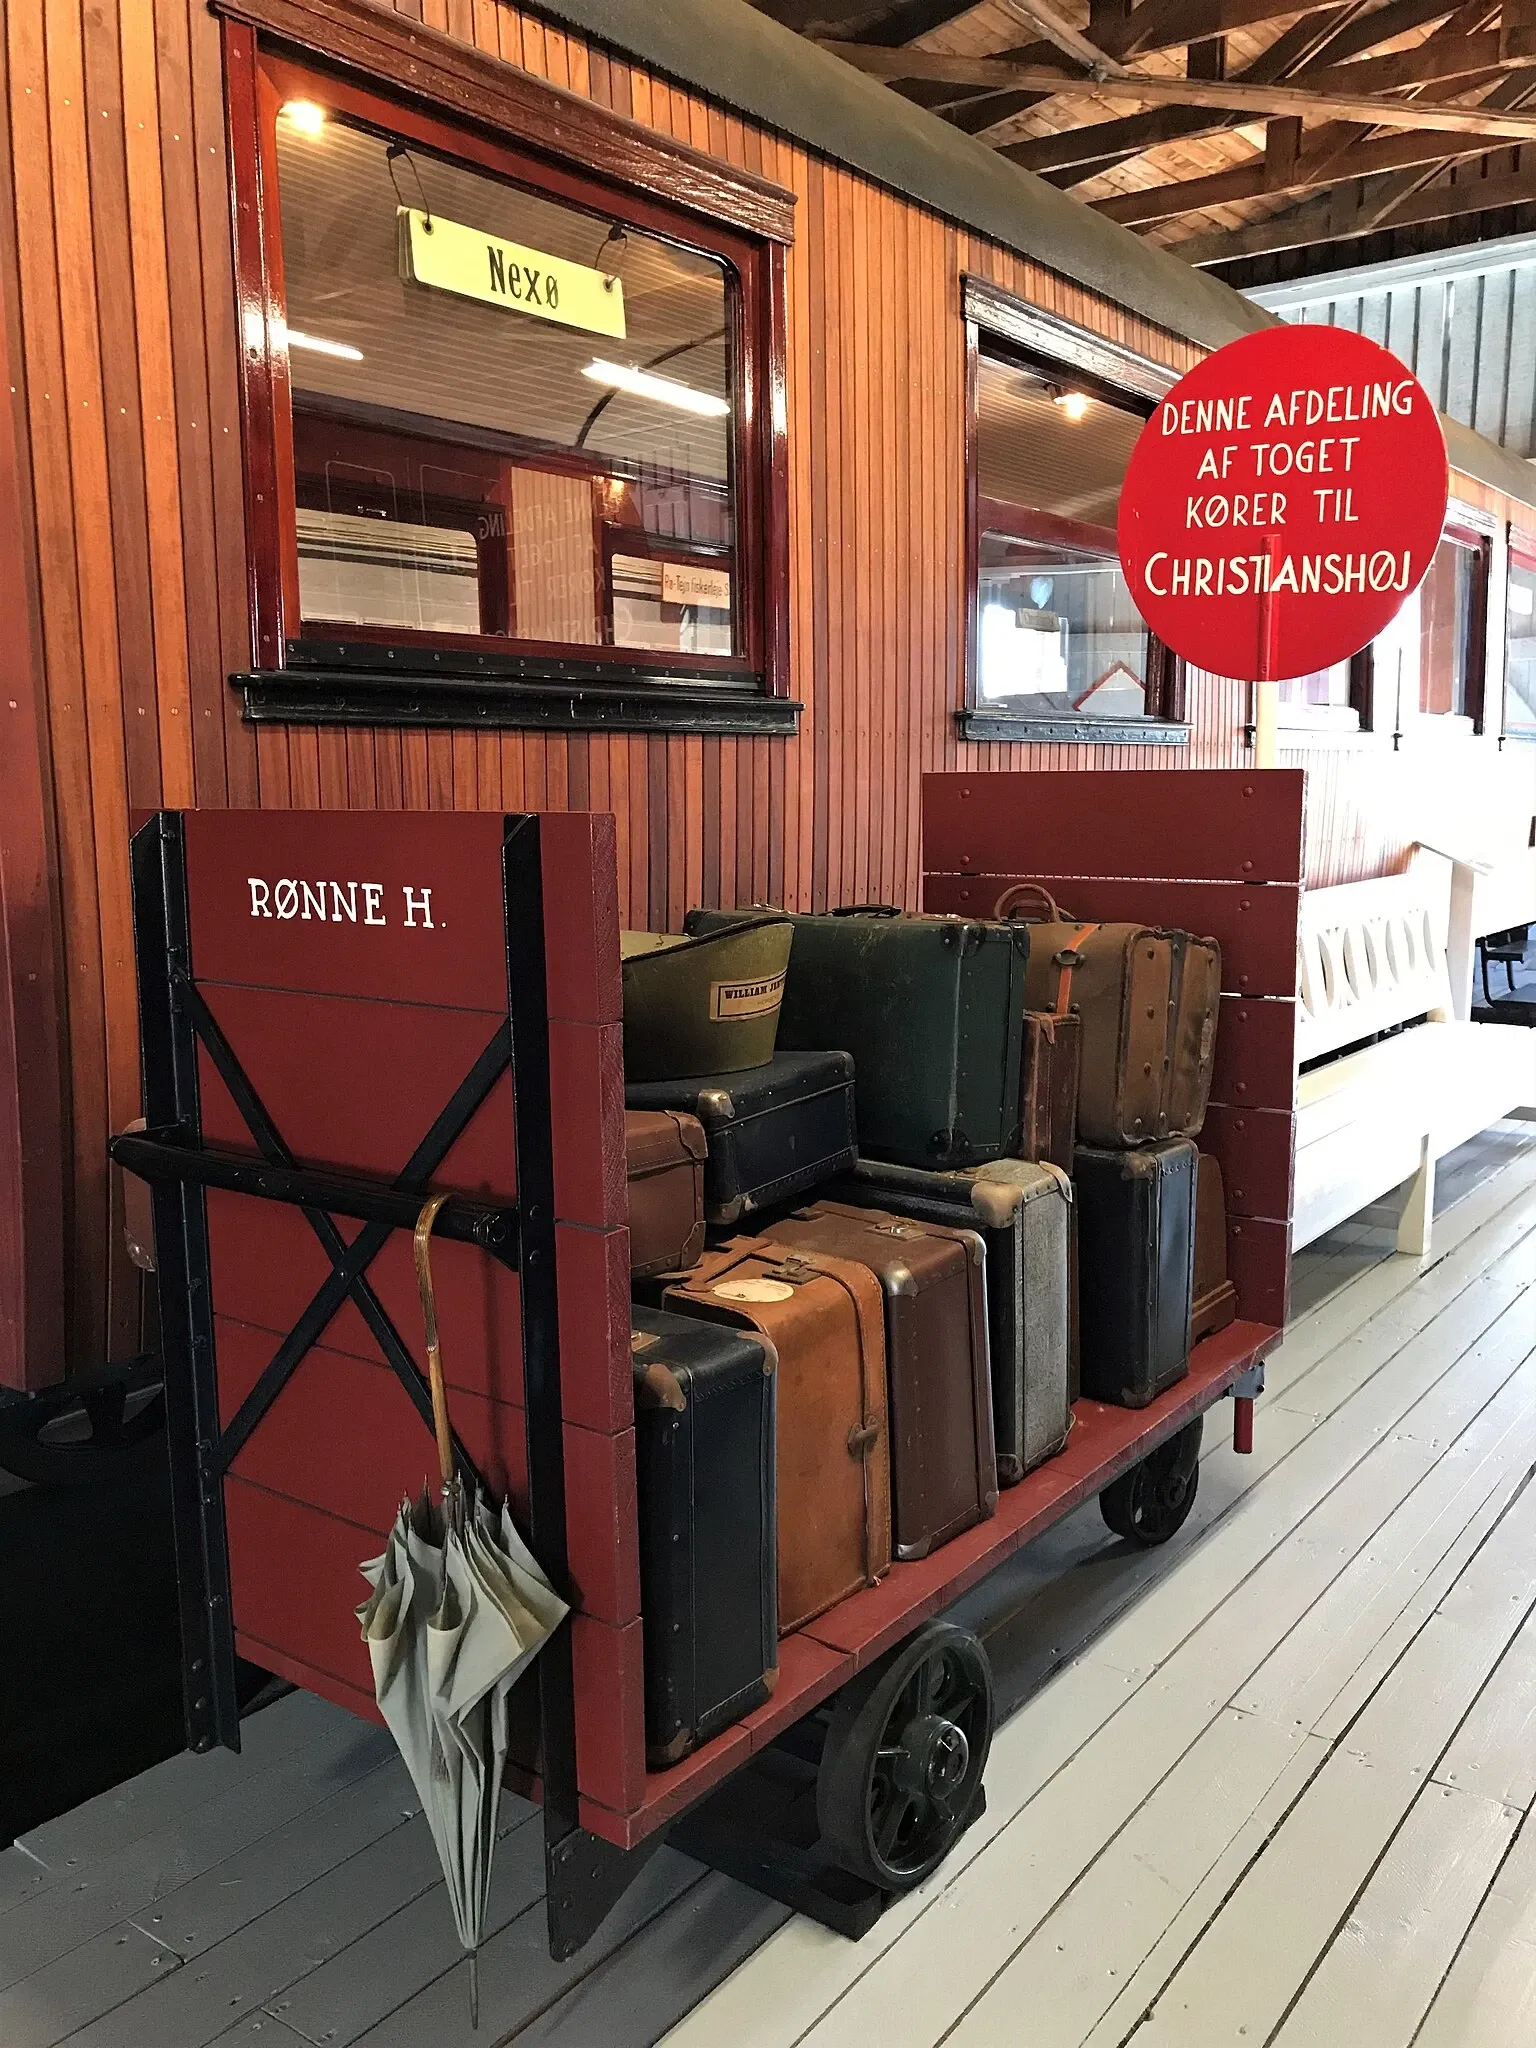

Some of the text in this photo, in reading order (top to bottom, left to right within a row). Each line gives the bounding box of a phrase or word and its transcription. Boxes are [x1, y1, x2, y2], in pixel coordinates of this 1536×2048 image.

[486, 245, 559, 309] Nexø
[1161, 379, 1414, 436] DENNE AFDELING
[1196, 436, 1360, 480] AF TOGET
[1186, 487, 1359, 529] KØRER TIL
[1144, 550, 1411, 596] CHRISTIANSHØJ
[247, 877, 448, 929] RØNNE H.
[724, 985, 768, 999] WILLIAM
